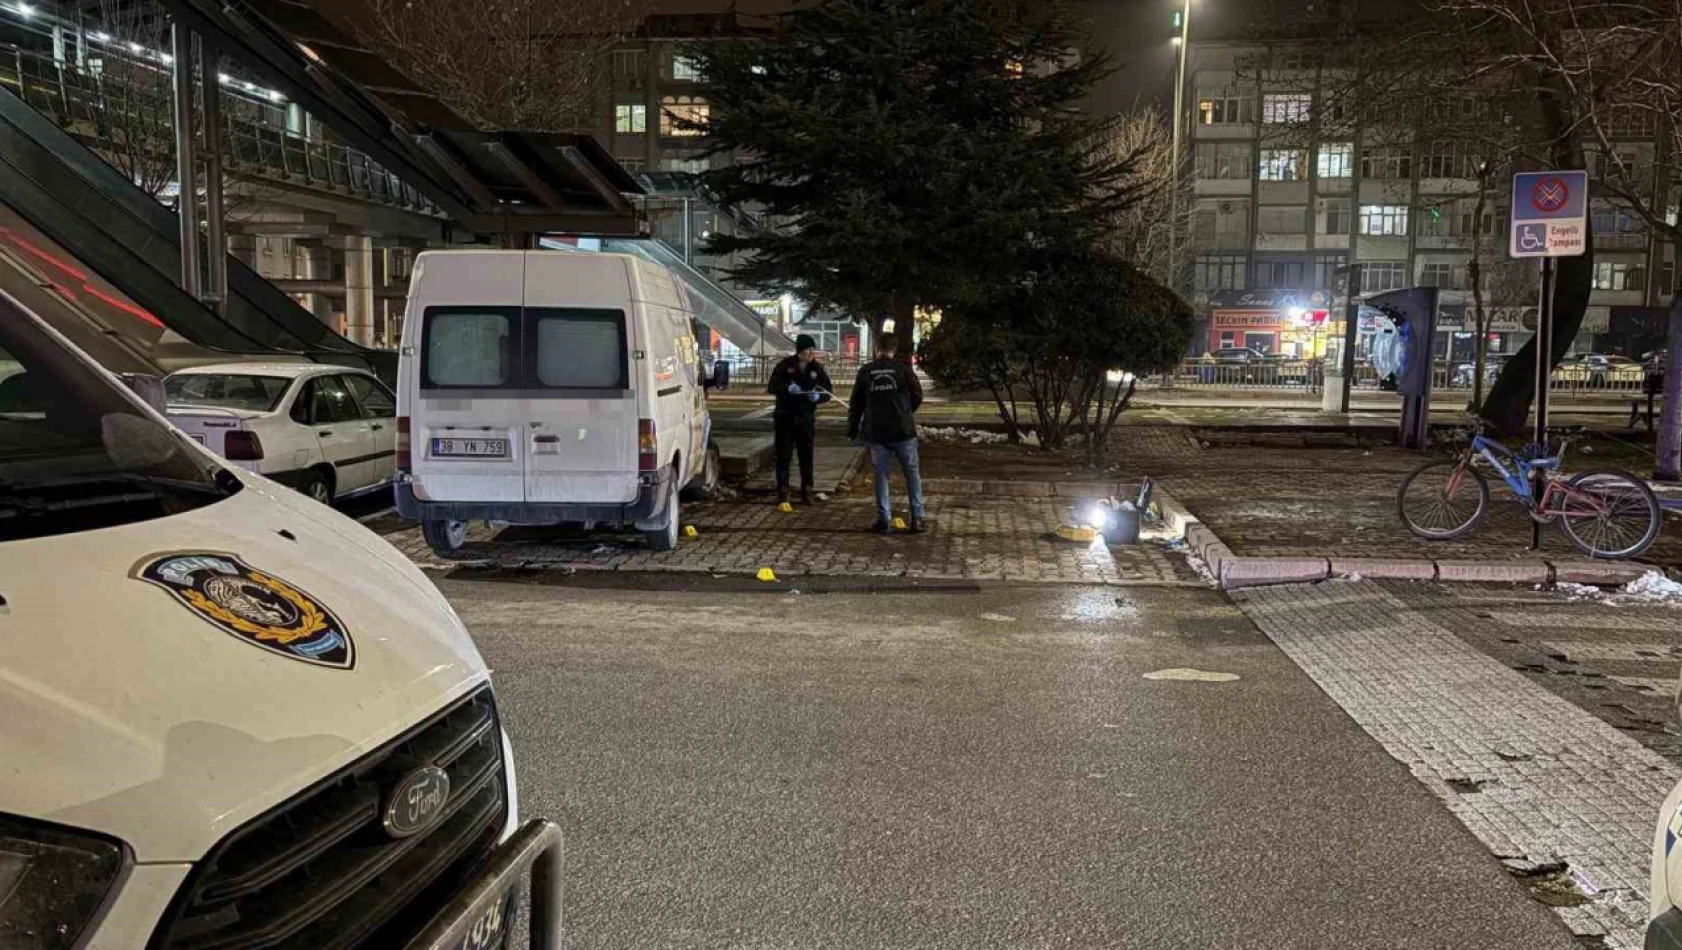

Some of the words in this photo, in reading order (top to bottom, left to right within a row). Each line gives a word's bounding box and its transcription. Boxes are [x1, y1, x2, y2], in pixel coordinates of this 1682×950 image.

[441, 440, 454, 452] 38
[463, 440, 477, 453] YN
[483, 441, 502, 453] 759
[408, 778, 441, 822] Ford
